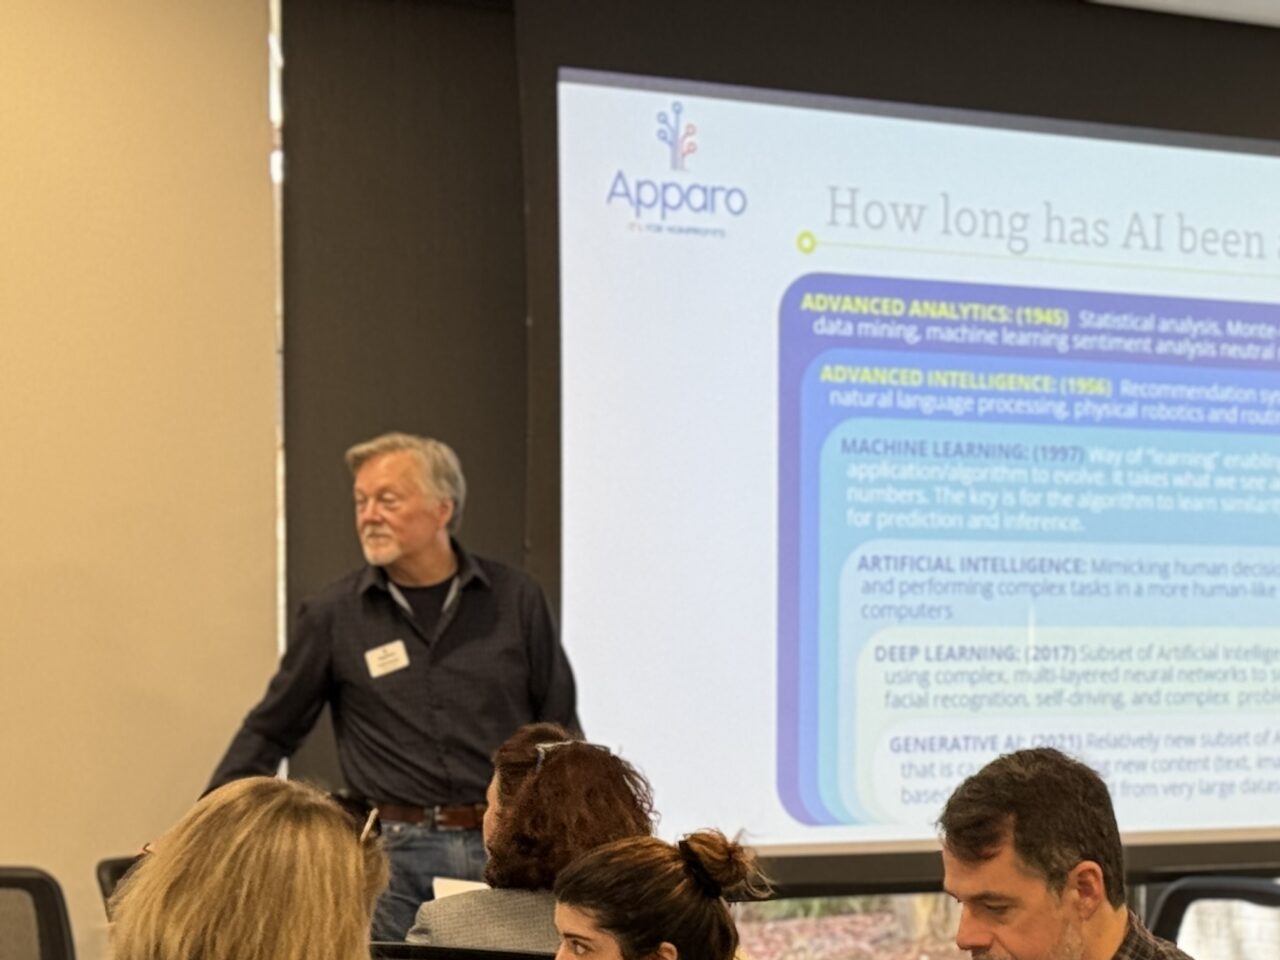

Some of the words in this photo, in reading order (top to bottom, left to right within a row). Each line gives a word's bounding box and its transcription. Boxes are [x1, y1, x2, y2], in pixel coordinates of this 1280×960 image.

[606, 170, 748, 220] Apparo
[827, 186, 927, 233] How
[940, 193, 1031, 256] long
[1044, 202, 1110, 249] has
[1122, 212, 1165, 252] AI
[1178, 212, 1267, 260] been
[801, 292, 905, 317] ADVANCED
[1079, 310, 1155, 331] Statistical
[813, 316, 853, 336] data
[926, 324, 998, 345] machine
[1001, 328, 1069, 353] learning
[1072, 333, 1151, 352] sentiment
[1155, 338, 1217, 361] analysis
[820, 364, 922, 387] ADVANCED
[1120, 380, 1258, 400] Recommendation
[829, 389, 892, 407] natural
[897, 390, 973, 414] language
[1074, 398, 1137, 422] physical
[1141, 402, 1205, 424] robotics
[1208, 404, 1237, 423] and
[840, 438, 928, 458] MACHINE
[1125, 447, 1144, 464] of
[1031, 466, 1049, 483] to
[1020, 489, 1042, 506] for
[1045, 489, 1073, 507] the
[1157, 494, 1175, 510] to
[847, 509, 872, 527] for
[876, 510, 963, 531] prediction
[968, 511, 999, 529] and
[857, 555, 954, 573] ARTIFICIAL
[1092, 557, 1170, 579] Mimicking
[1173, 560, 1229, 577] human
[861, 579, 895, 595] and
[899, 579, 995, 600] performing
[998, 580, 1067, 599] complex
[1070, 580, 1111, 597] tasks
[1116, 581, 1131, 597] in
[1134, 586, 1143, 598] a
[1146, 585, 1189, 598] more
[874, 645, 920, 662] DEEP
[925, 645, 1021, 663] LEARNING:
[1025, 645, 1077, 665] (2017)
[1079, 644, 1133, 661] Subset
[1137, 644, 1155, 661] of
[1157, 644, 1219, 661] Artificial
[885, 668, 931, 688] using
[1123, 667, 1174, 683] neural
[1177, 667, 1247, 683] networks
[1251, 668, 1268, 683] to
[885, 690, 929, 709] facial
[1132, 689, 1161, 705] and
[1165, 689, 1230, 707] complex
[889, 735, 999, 753] GENERATIVE
[1086, 731, 1160, 752] Relatively
[1164, 733, 1196, 747] new
[1200, 729, 1250, 747] subset
[1254, 728, 1270, 746] of
[901, 761, 937, 778] that
[940, 761, 954, 778] is
[1114, 758, 1147, 773] new
[1152, 756, 1210, 773] content
[1120, 781, 1158, 797] from
[1162, 781, 1194, 800] very
[1198, 779, 1236, 798] large
